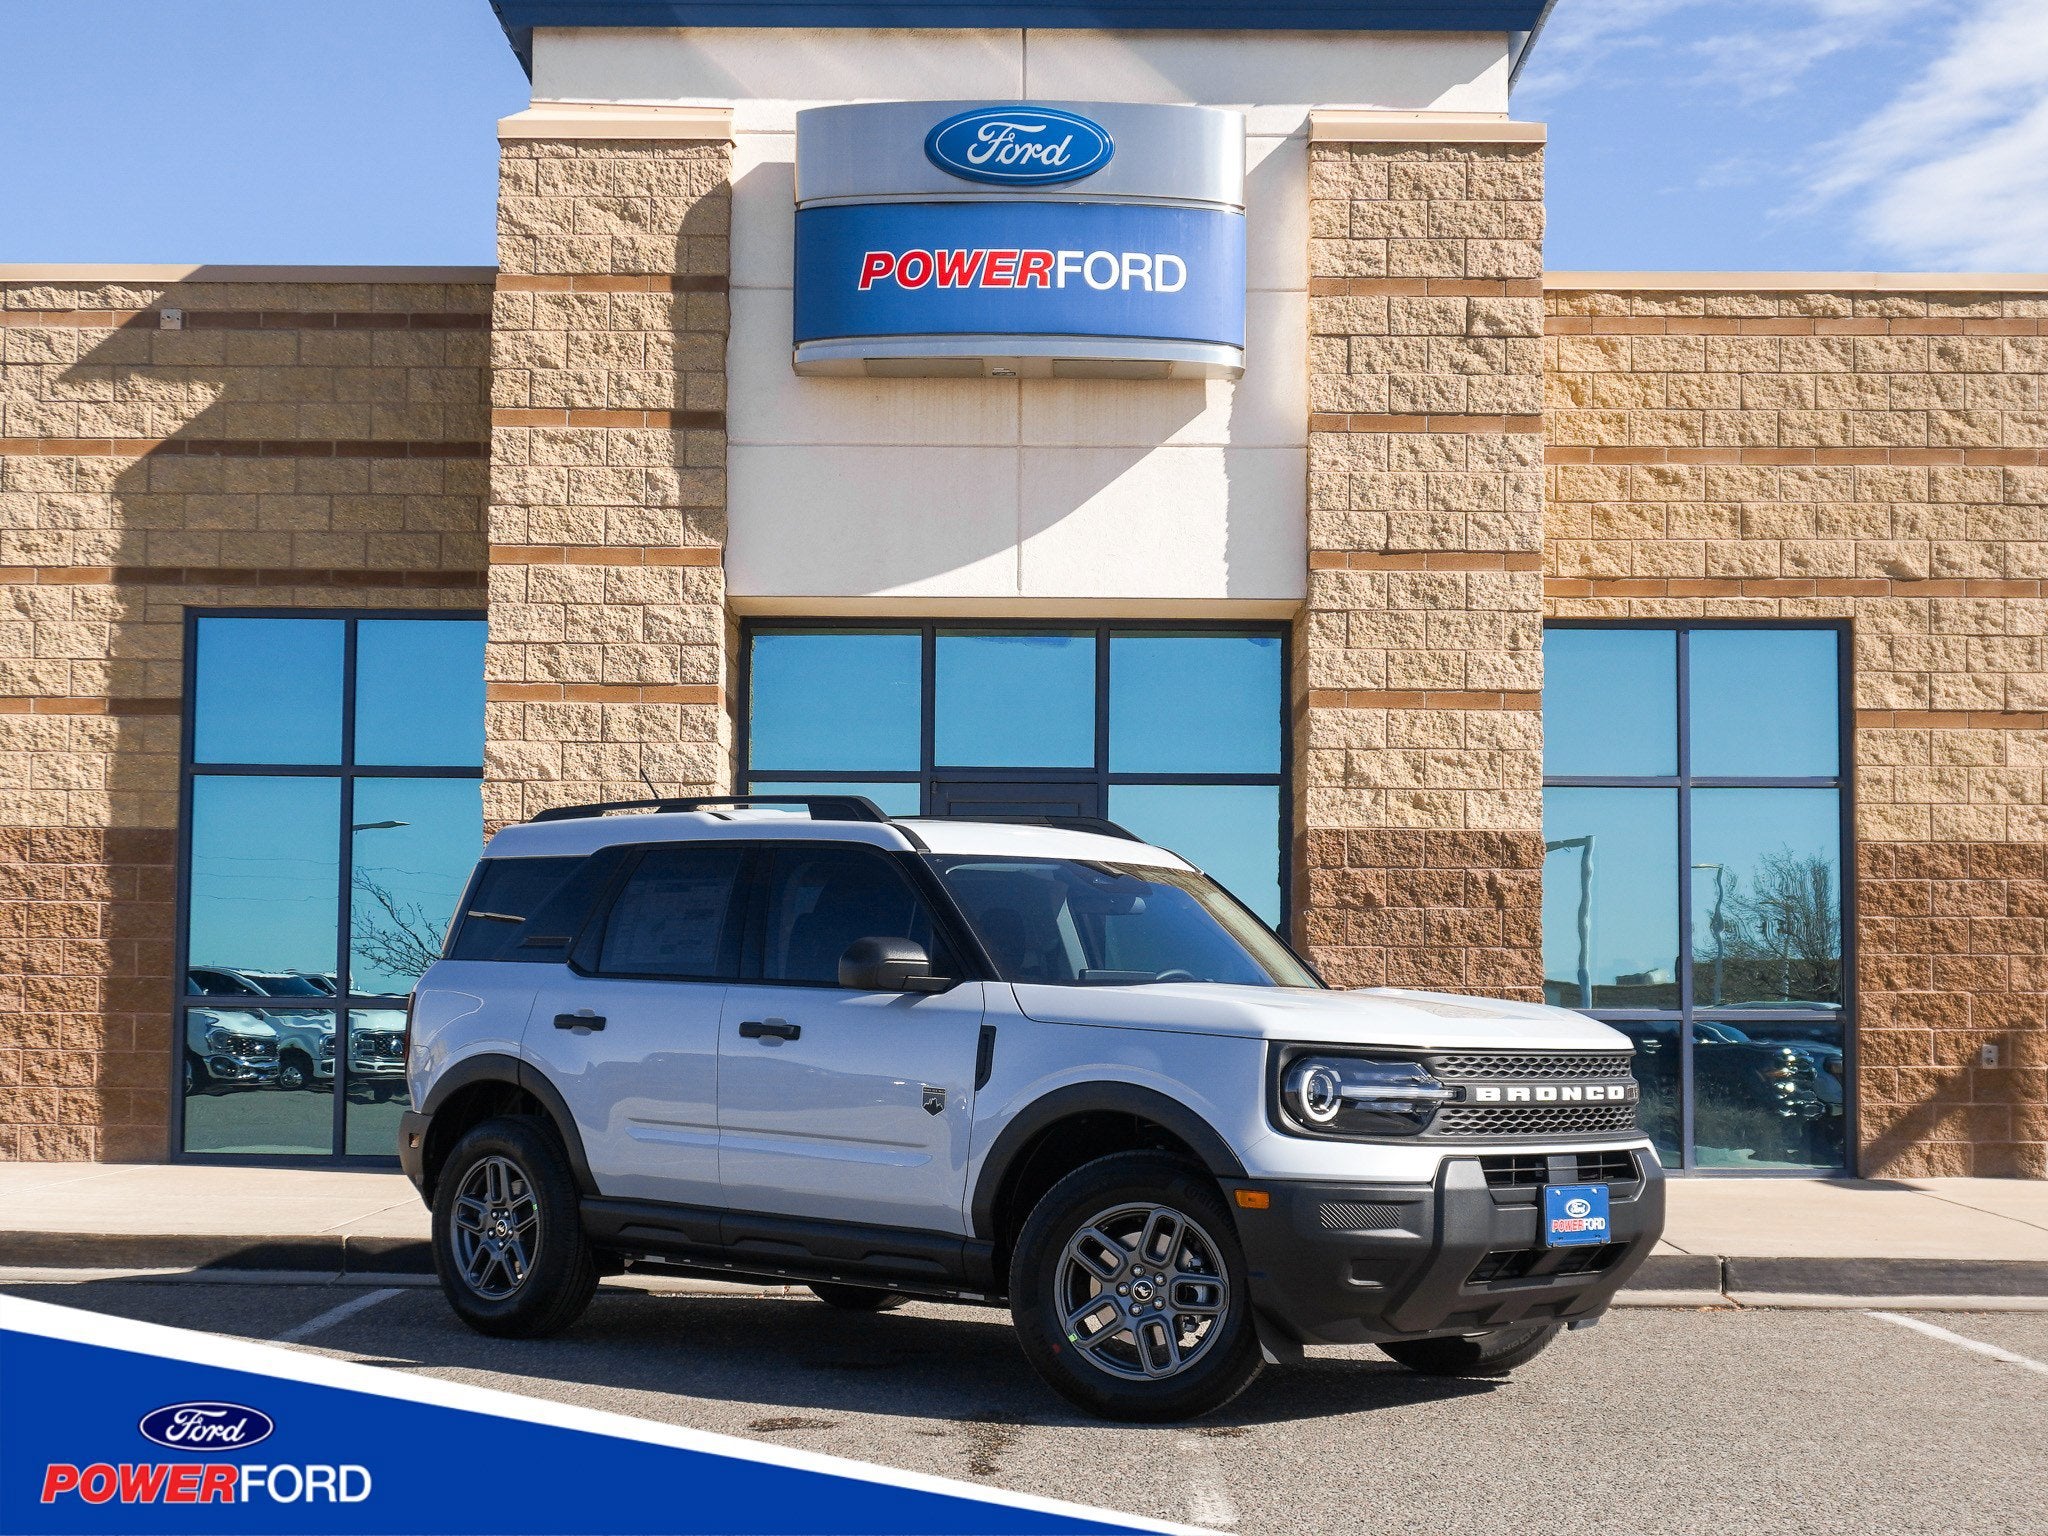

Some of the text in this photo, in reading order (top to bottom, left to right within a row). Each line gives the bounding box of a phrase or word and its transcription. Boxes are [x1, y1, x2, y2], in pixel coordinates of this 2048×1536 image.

[967, 122, 1072, 166] Ford
[857, 248, 1188, 293] POWERFORD
[1475, 1085, 1625, 1102] BRONCO
